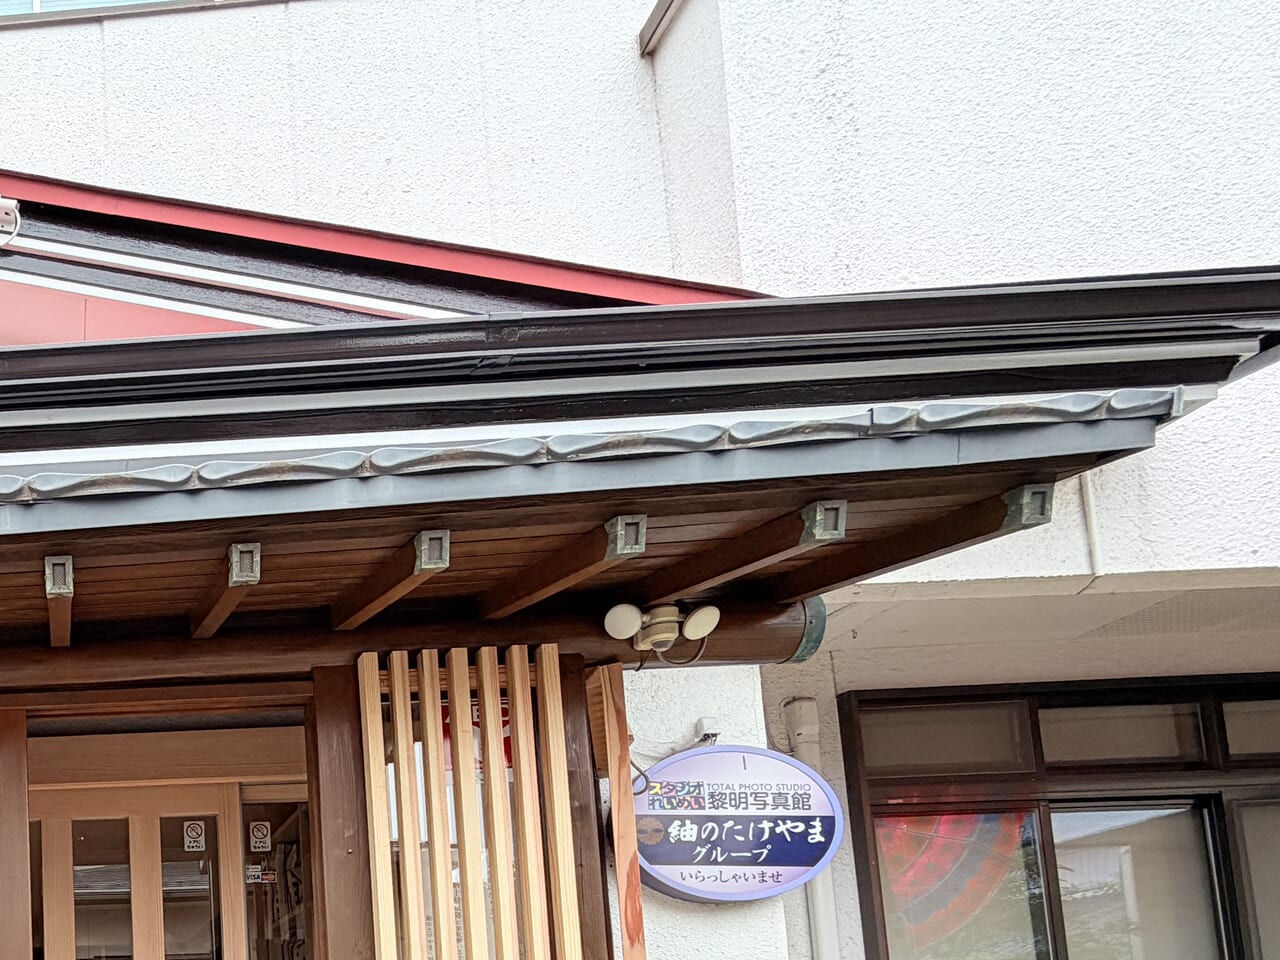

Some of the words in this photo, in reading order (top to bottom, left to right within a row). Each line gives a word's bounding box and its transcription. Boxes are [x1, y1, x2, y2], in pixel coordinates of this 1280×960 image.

[648, 781, 704, 796] スタジオ
[707, 783, 737, 792] TOTAL
[739, 783, 773, 792] PHOTO
[776, 783, 812, 792] STUDIO
[648, 796, 705, 810] れいめい
[707, 792, 812, 811] 黎明写真館
[668, 818, 826, 843] 紬のたけやま
[692, 844, 772, 864] グループ
[680, 871, 783, 884] いらっしゃいませ
